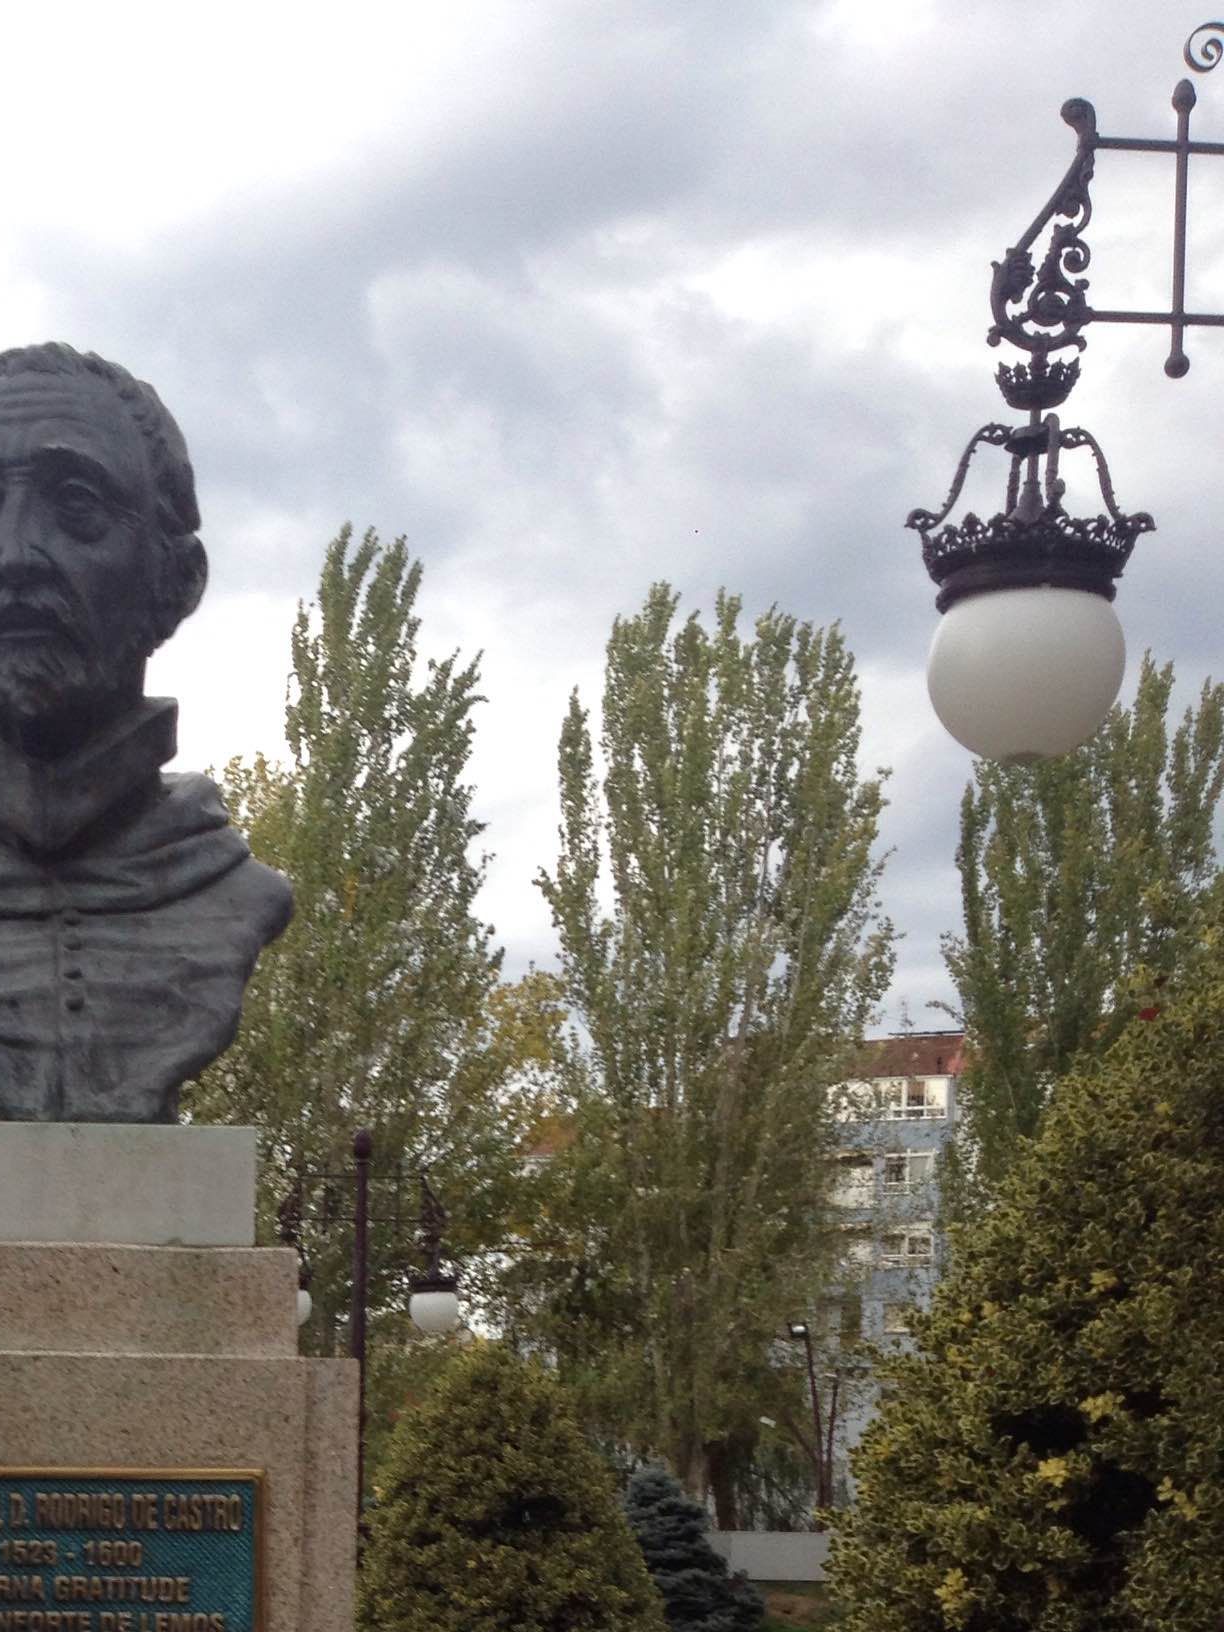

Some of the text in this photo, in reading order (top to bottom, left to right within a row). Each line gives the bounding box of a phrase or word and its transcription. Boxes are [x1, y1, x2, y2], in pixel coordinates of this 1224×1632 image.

[10, 1492, 29, 1526] D.
[35, 1492, 125, 1530] RODRIGO
[131, 1493, 158, 1530] DE
[163, 1493, 243, 1531] CASTRO
[82, 1540, 143, 1567] 1600
[53, 1575, 190, 1602] GRATITUDE
